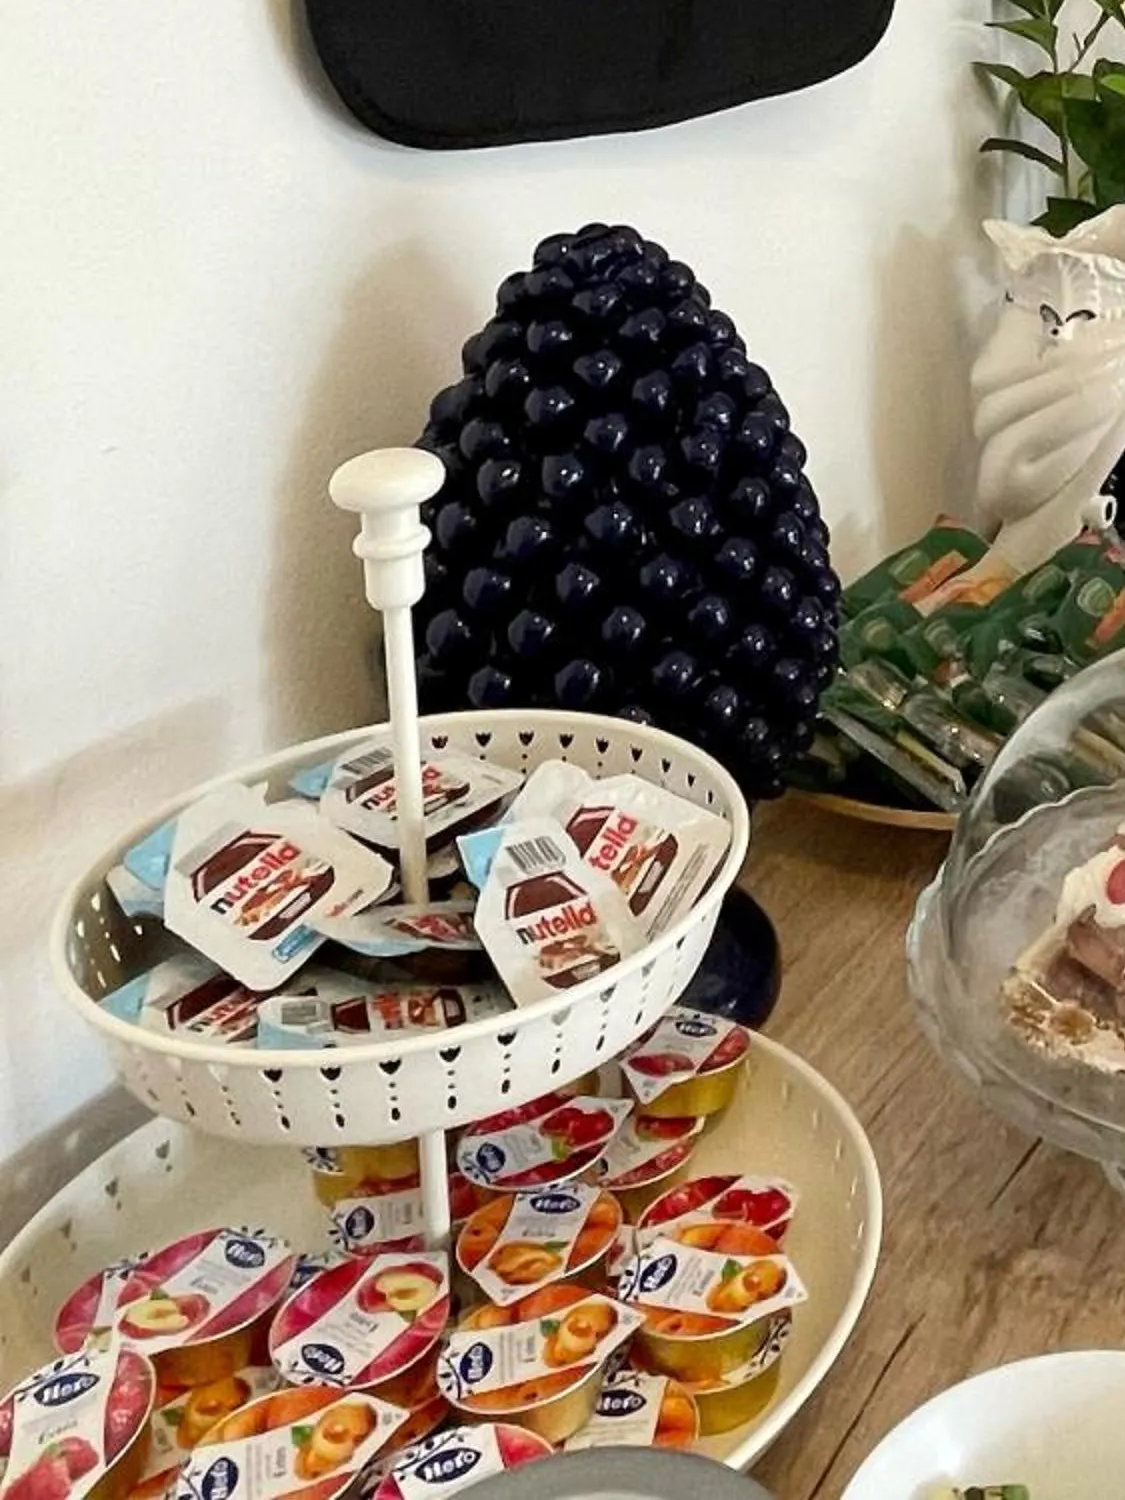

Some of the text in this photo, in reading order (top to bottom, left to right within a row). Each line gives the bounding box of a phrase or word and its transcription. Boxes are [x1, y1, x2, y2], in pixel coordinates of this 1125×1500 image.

[587, 812, 640, 874] tella
[210, 840, 302, 916] nutella
[515, 901, 598, 946] nutella
[423, 1450, 476, 1481] Hero
